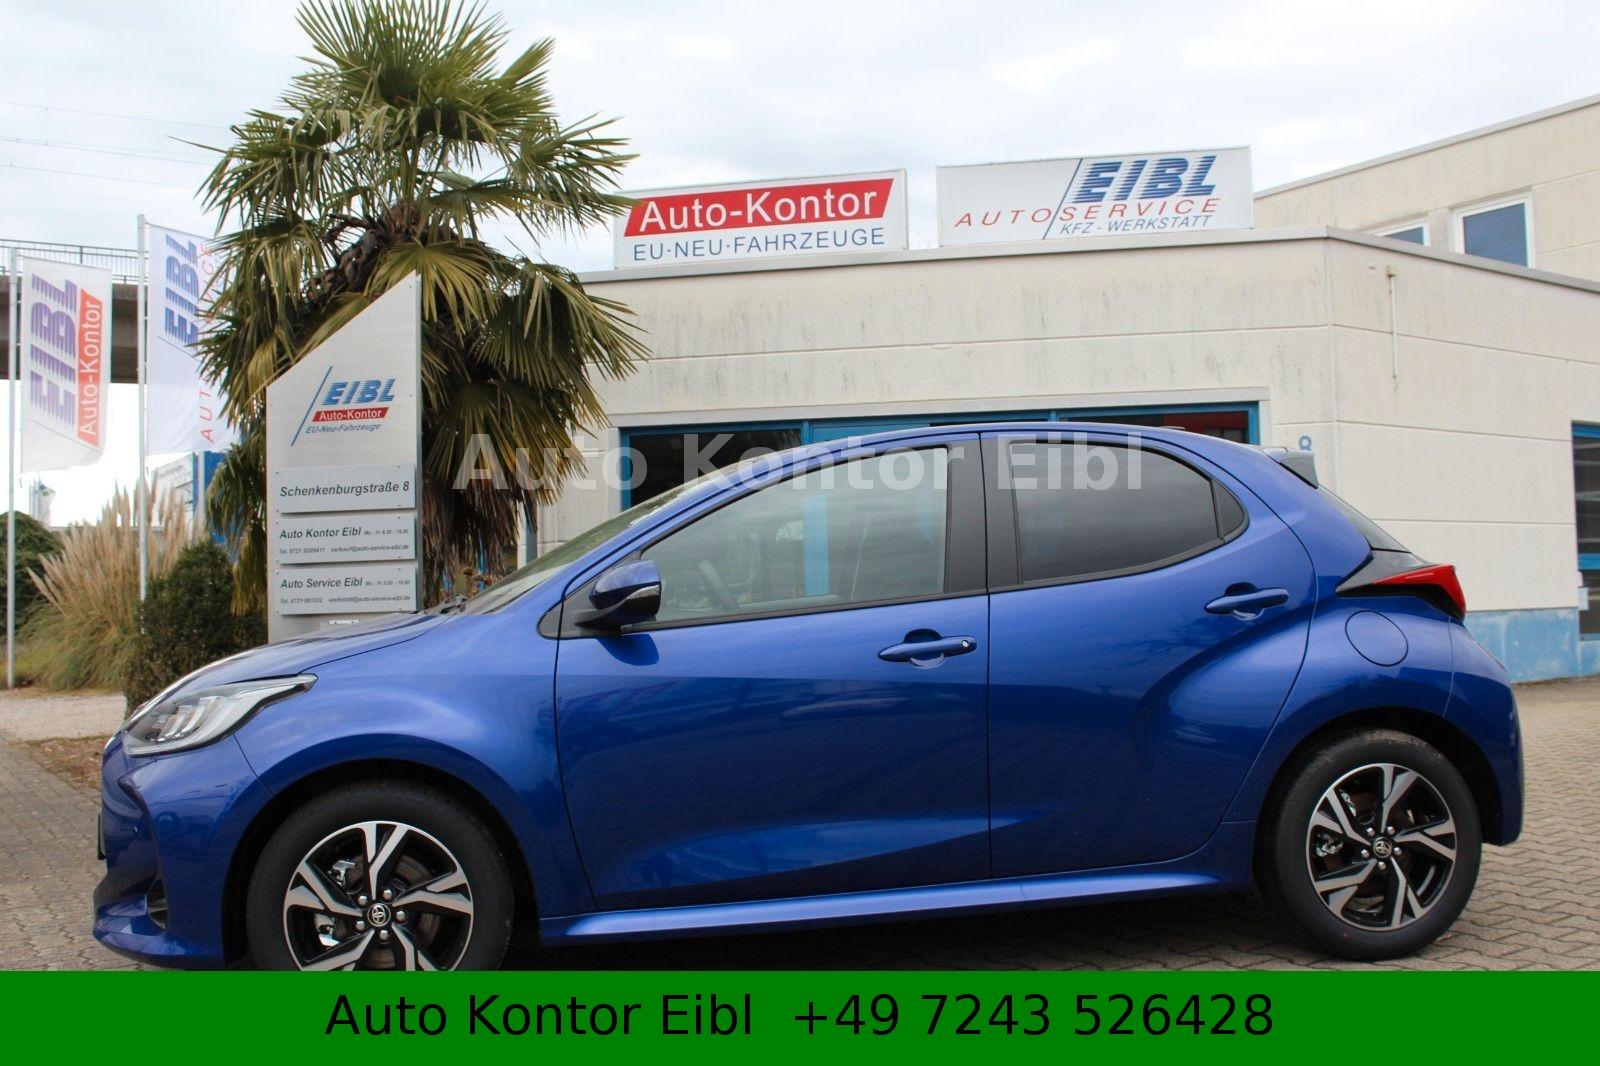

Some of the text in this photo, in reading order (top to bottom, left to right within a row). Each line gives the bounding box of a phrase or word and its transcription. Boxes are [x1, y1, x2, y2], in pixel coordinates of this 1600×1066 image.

[1072, 154, 1217, 204] EIBL
[639, 188, 878, 233] Auto-Kontor
[164, 233, 200, 347] EIBL
[30, 272, 78, 429] EIBL
[80, 299, 103, 437] Auto-Kontor
[322, 379, 396, 405] EIBL
[319, 409, 382, 421] Auto-Kontor
[280, 480, 410, 498] Schenkenburgstraße 8
[279, 529, 303, 540] Auto
[306, 528, 340, 538] Kontor
[342, 526, 362, 537] Eibl
[280, 579, 303, 589] Auto
[306, 577, 342, 588] Service
[344, 576, 363, 587] Eibl
